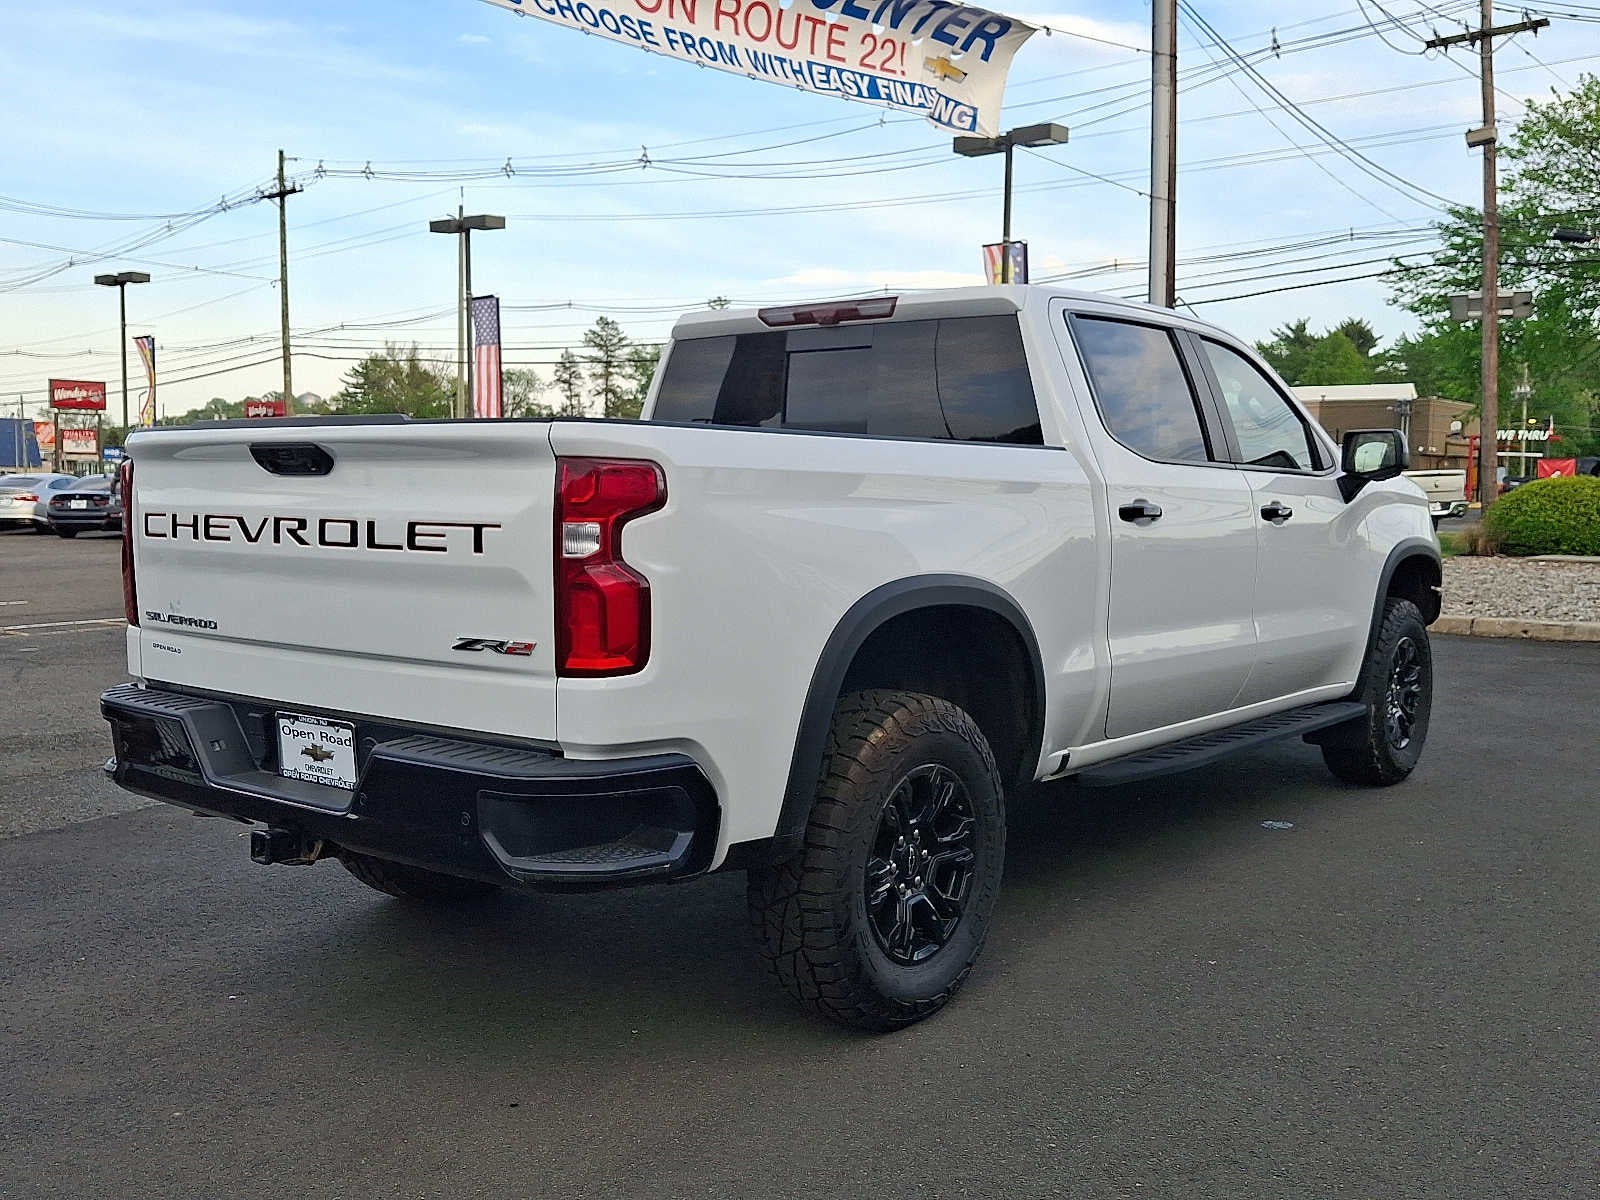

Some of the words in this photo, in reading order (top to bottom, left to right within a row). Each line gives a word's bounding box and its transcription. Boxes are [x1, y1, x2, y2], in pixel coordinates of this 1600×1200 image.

[714, 0, 849, 62] ROUTE
[859, 33, 906, 76] 22!
[534, 0, 660, 47] CHOOSE
[663, 27, 743, 68] FROM
[744, 47, 808, 85] WITH
[811, 64, 870, 98] EASY
[1518, 429, 1549, 440] THRU
[144, 512, 502, 554] CHEVROLET
[145, 611, 218, 629] SILVERADO
[152, 642, 166, 651] OPEN
[167, 645, 182, 654] ROAD
[451, 637, 537, 656] ZR2
[282, 725, 315, 740] Open
[320, 731, 352, 747] Road
[283, 769, 300, 779] OPEN
[301, 773, 318, 782] ROAD
[319, 776, 355, 790] CHEVROLET
[304, 763, 334, 776] CHEVROLET
